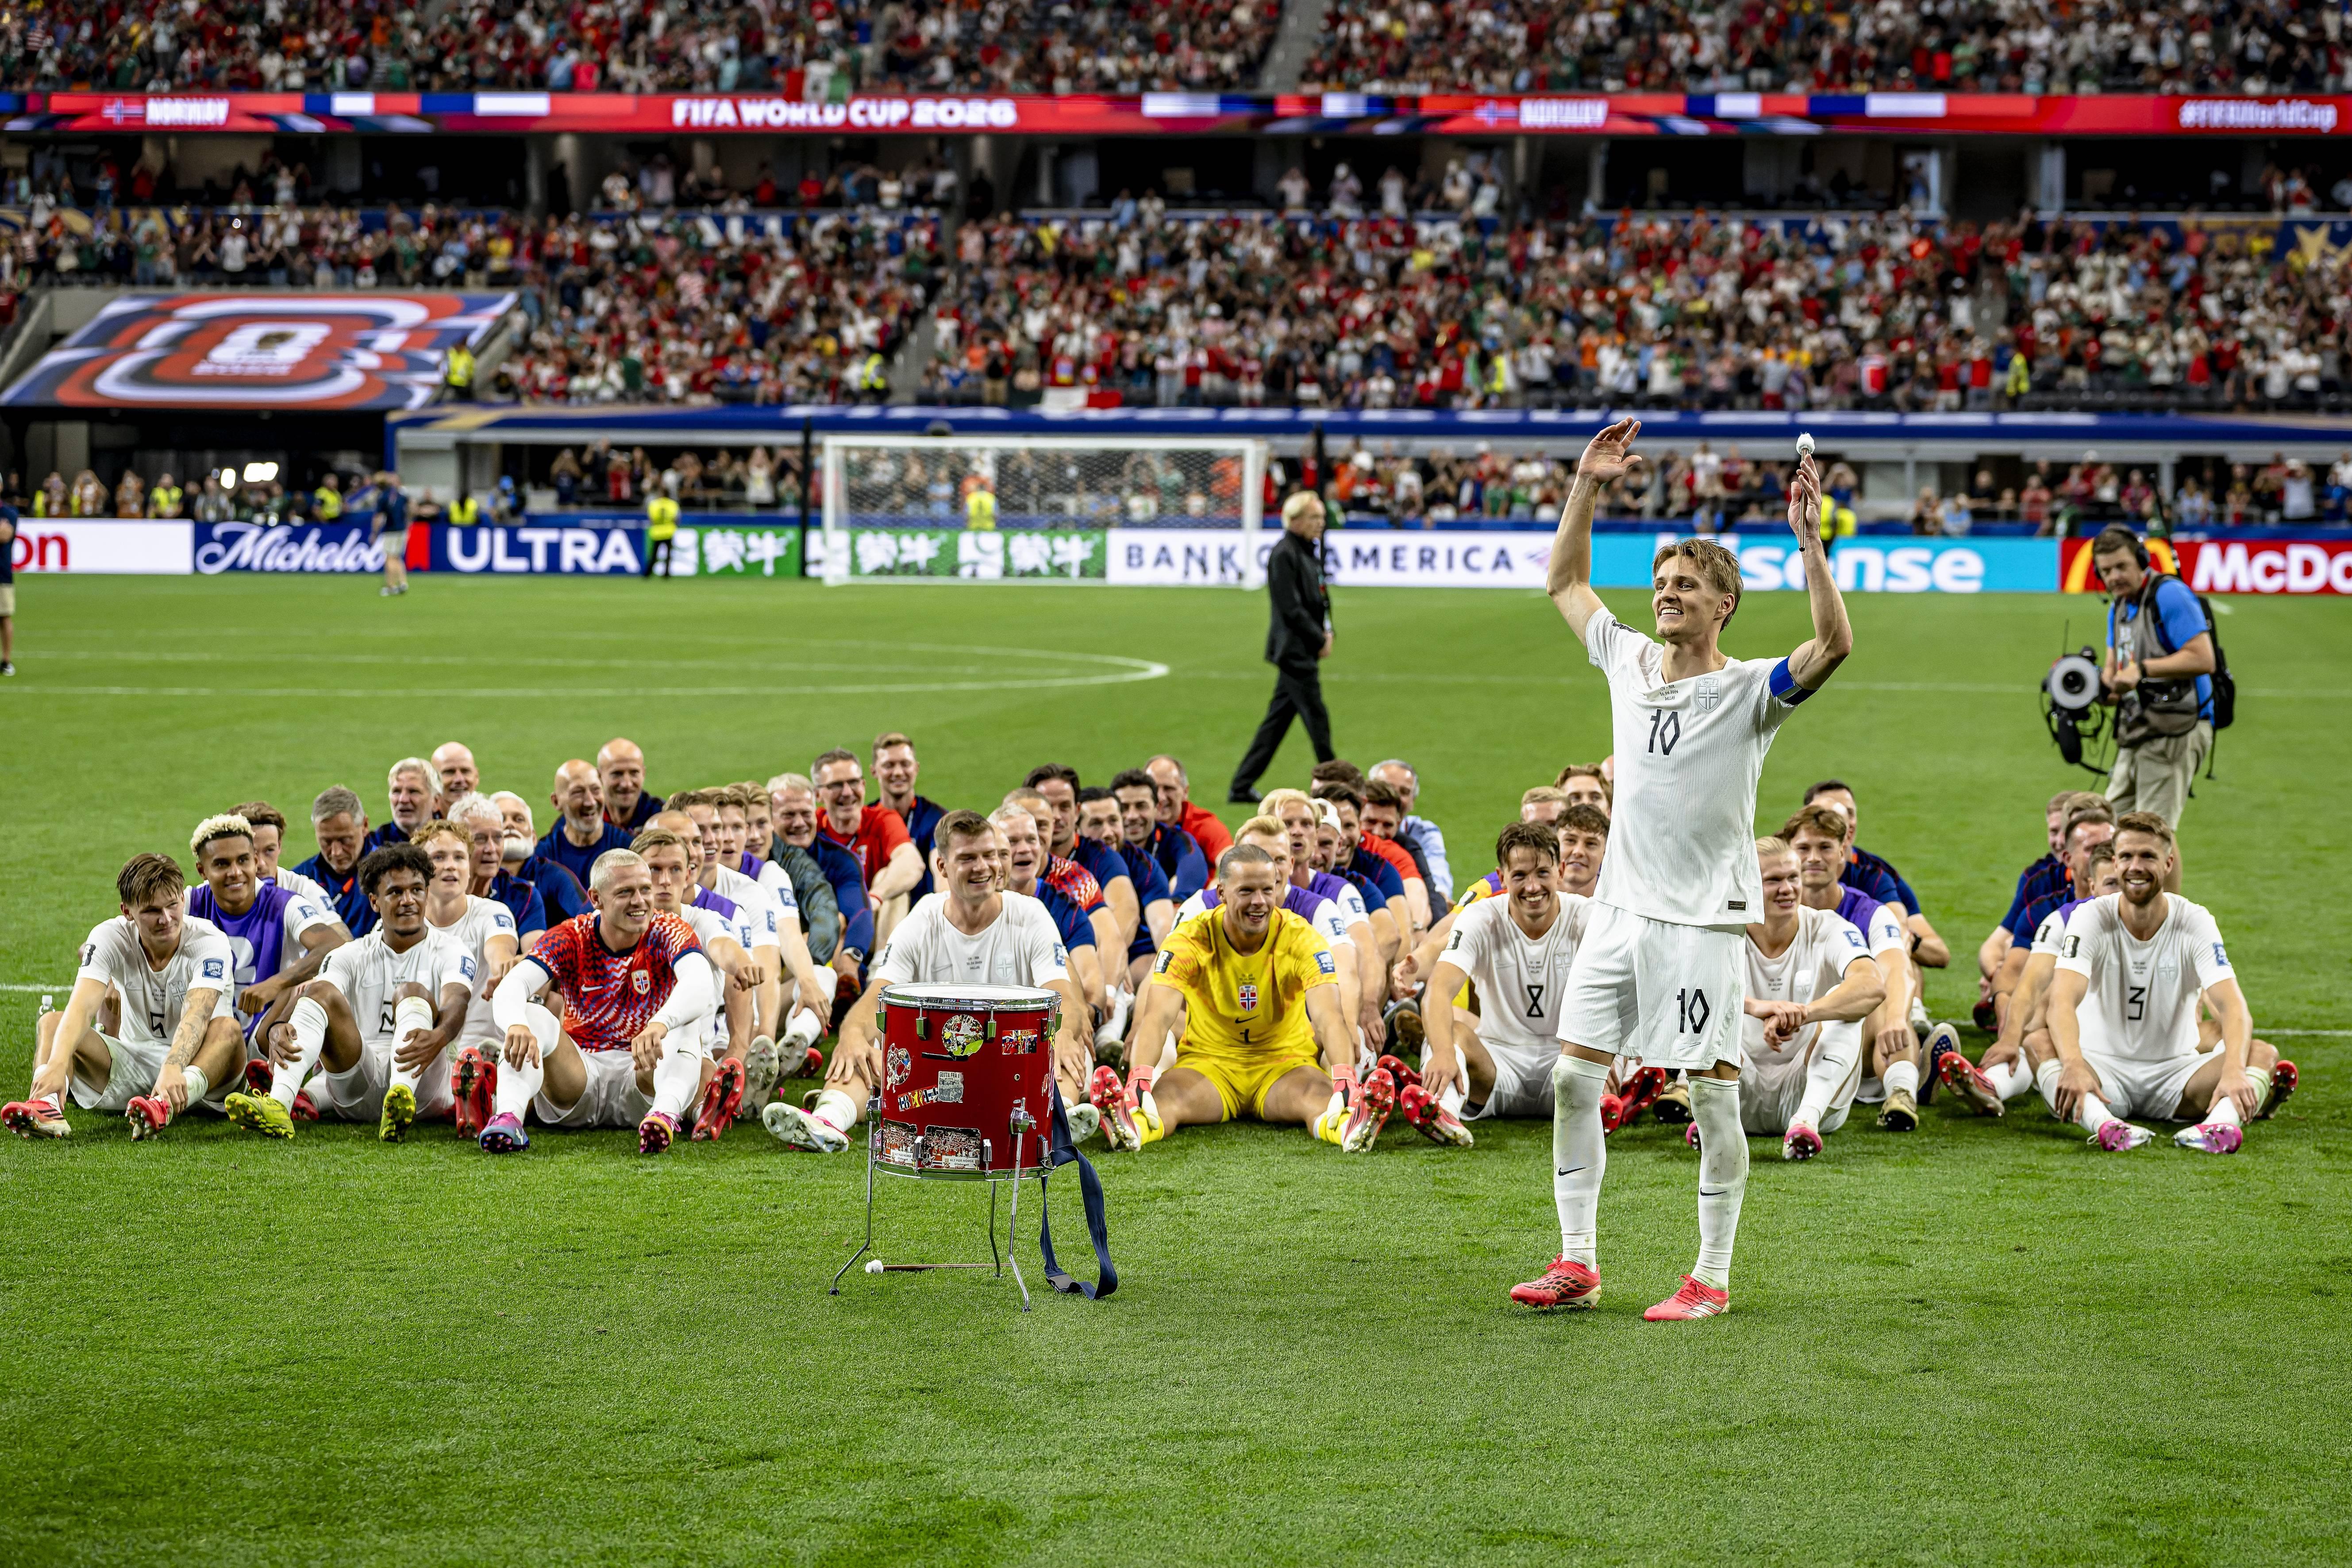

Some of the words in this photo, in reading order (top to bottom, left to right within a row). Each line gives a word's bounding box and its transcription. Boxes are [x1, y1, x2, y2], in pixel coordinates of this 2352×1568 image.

[672, 98, 738, 127] FIFA
[848, 98, 910, 127] CUP
[911, 98, 1017, 127] 2026
[196, 521, 388, 574] Michelob
[446, 527, 641, 573] ULTRA
[1127, 544, 1240, 572] BANK
[1648, 709, 1680, 755] 10
[1527, 985, 1544, 1017] 8
[1677, 988, 1710, 1034] 10
[2128, 986, 2145, 1020] 3
[150, 1011, 167, 1038] 5
[1240, 1028, 1250, 1043] 1
